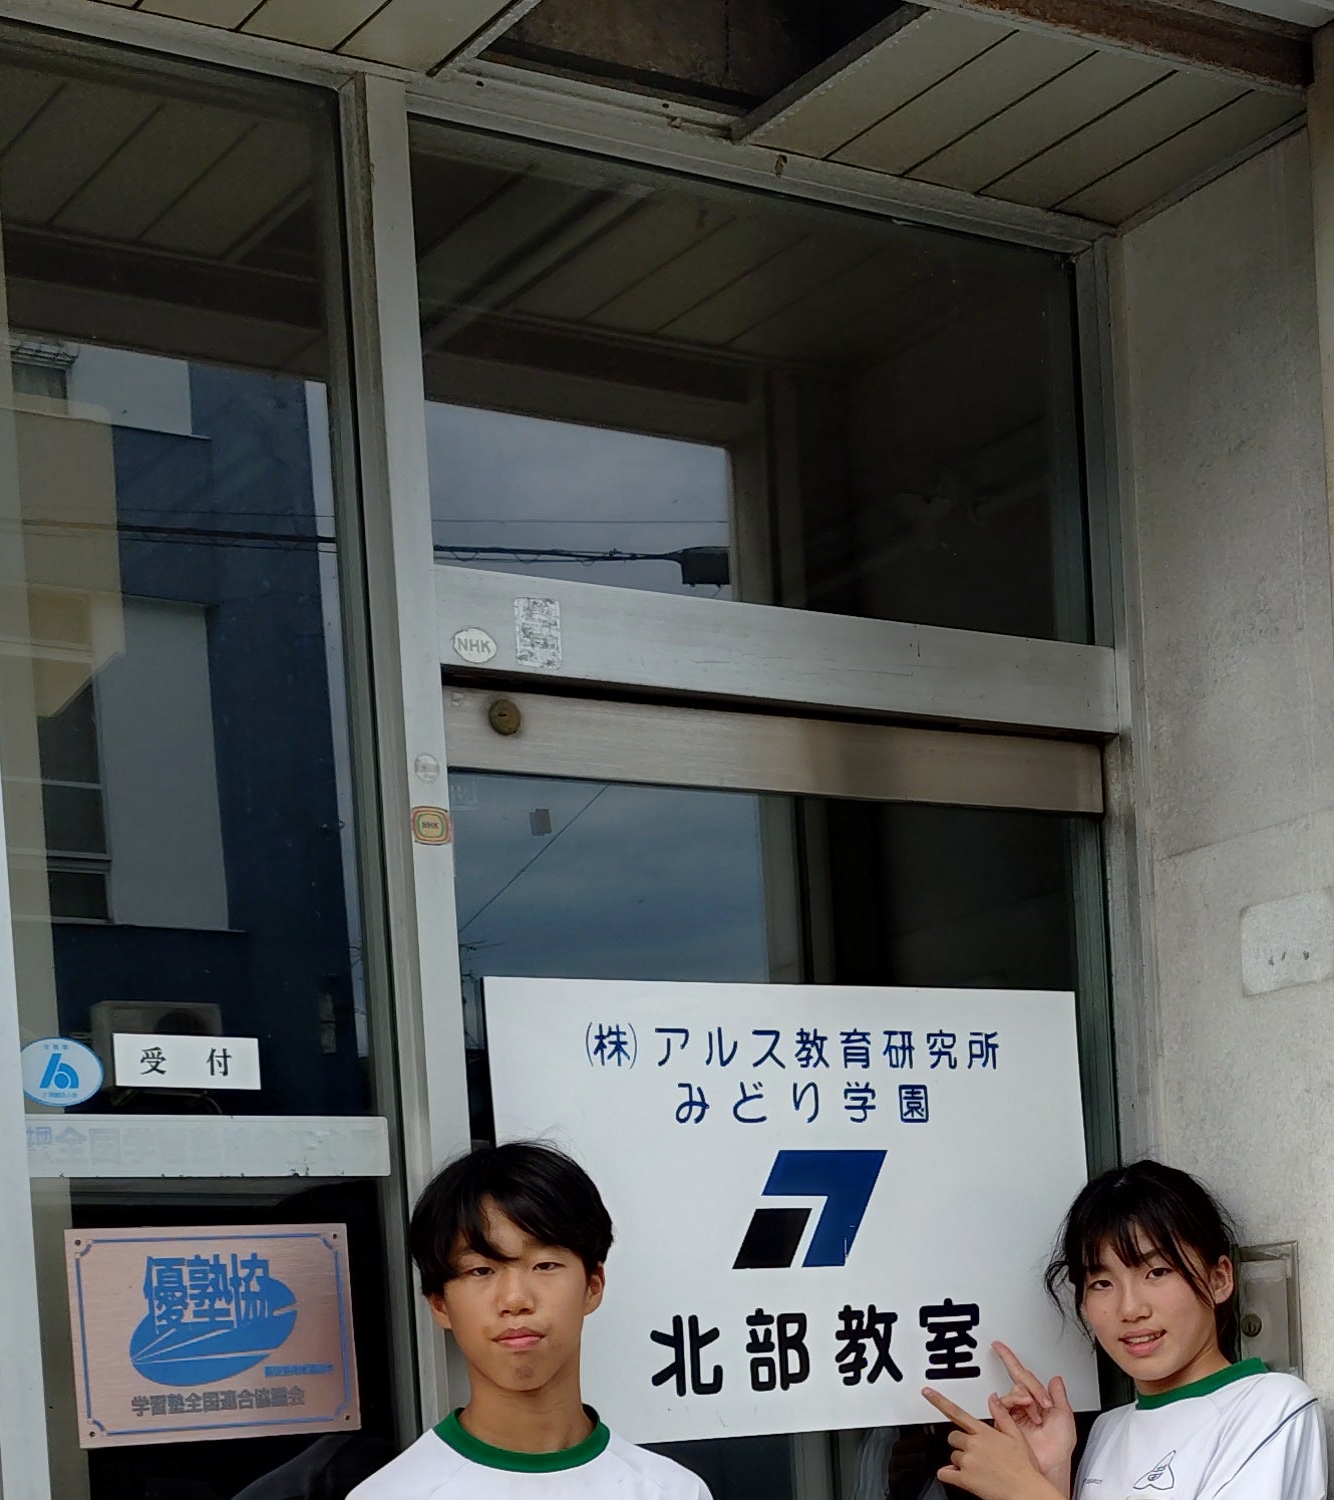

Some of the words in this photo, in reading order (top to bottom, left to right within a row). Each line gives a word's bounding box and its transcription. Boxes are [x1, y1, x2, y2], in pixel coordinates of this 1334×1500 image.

[457, 637, 492, 654] NHK
[139, 1047, 233, 1077] 受付
[674, 1081, 930, 1125] みどり学園
[143, 1253, 269, 1333] 優塾協
[650, 1298, 982, 1398] 北部教室
